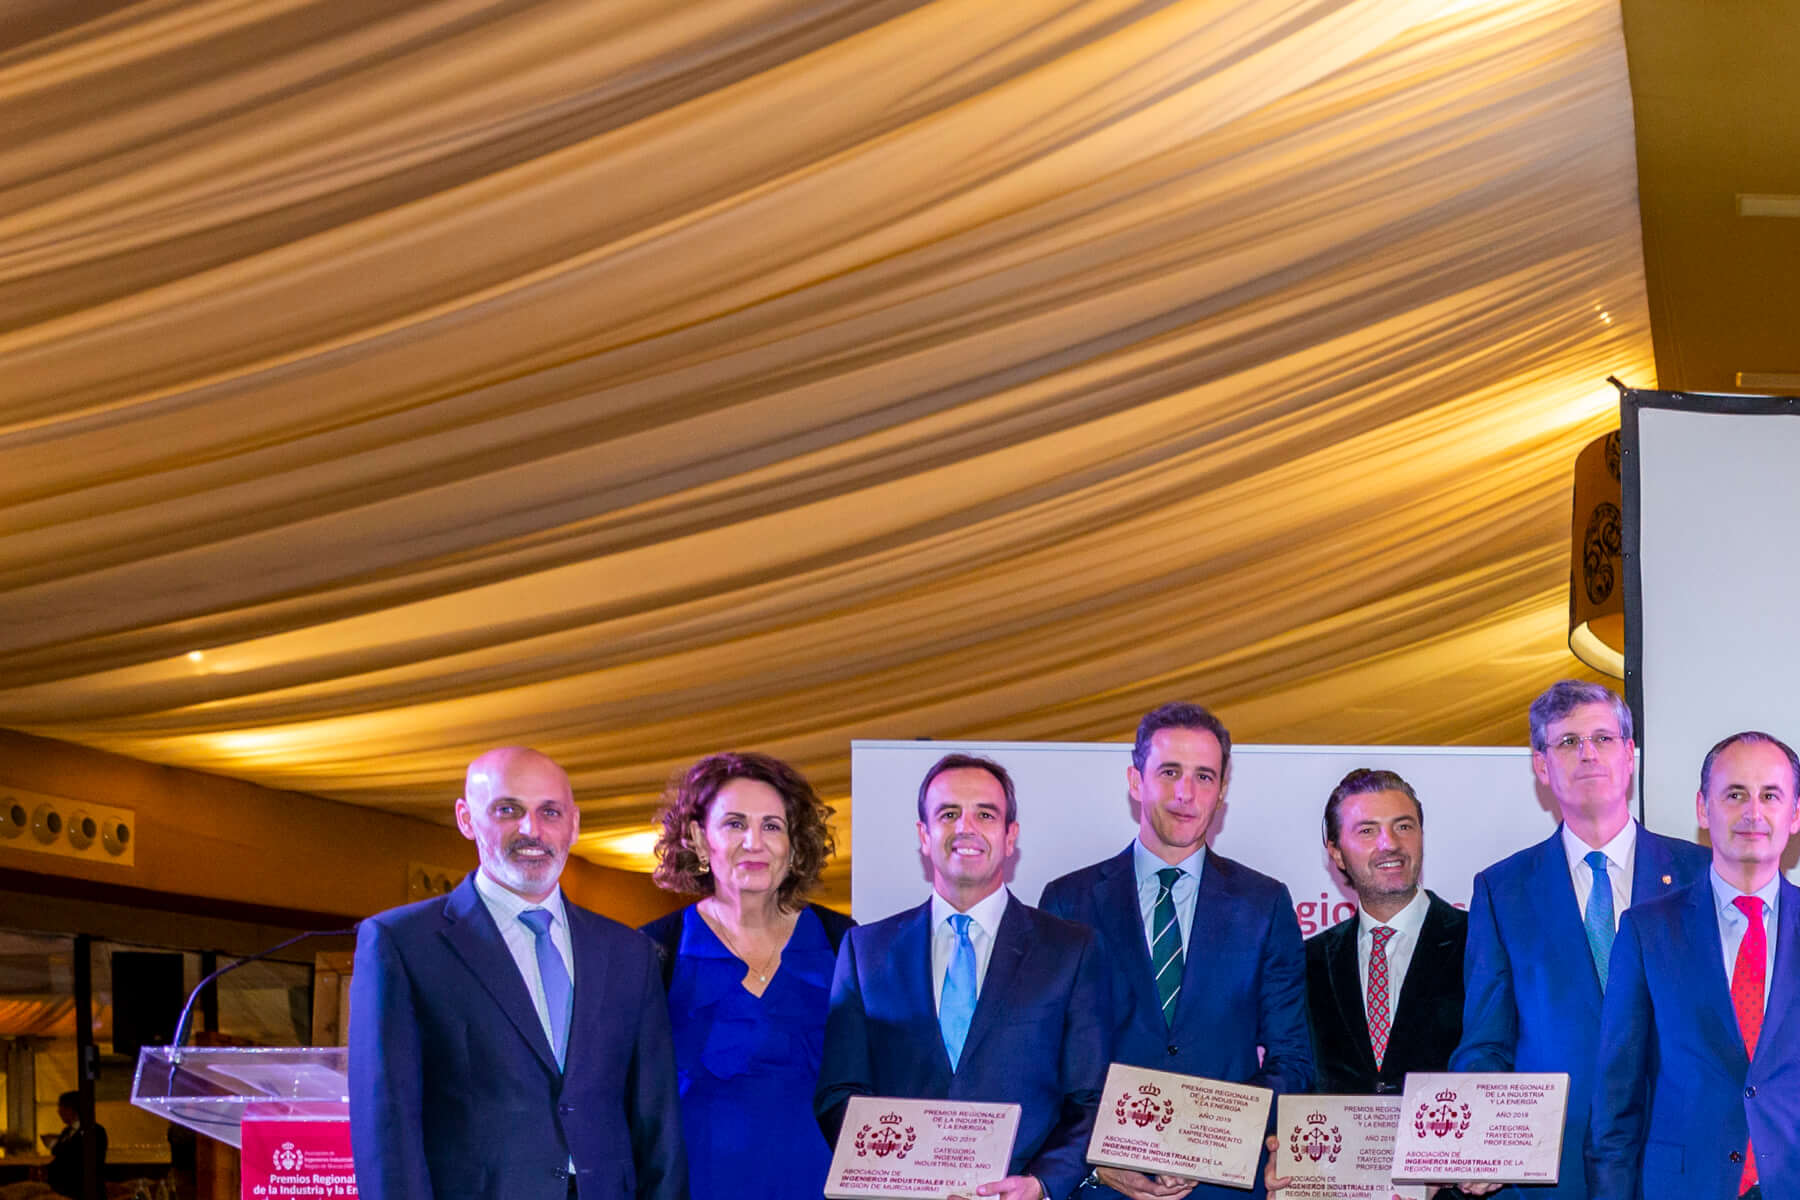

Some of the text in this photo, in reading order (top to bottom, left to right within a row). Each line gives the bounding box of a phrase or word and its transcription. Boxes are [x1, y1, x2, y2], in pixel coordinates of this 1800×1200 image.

[1102, 1142, 1147, 1154] INGENIEROS
[1149, 1148, 1200, 1162] INDUSTRIALES
[270, 1173, 356, 1186] Premios Regional
[889, 1177, 944, 1186] INDUSTRIALES
[253, 1185, 266, 1195] de
[268, 1185, 278, 1195] la
[280, 1185, 324, 1195] Industria
[326, 1187, 333, 1197] y
[335, 1185, 345, 1195] la
